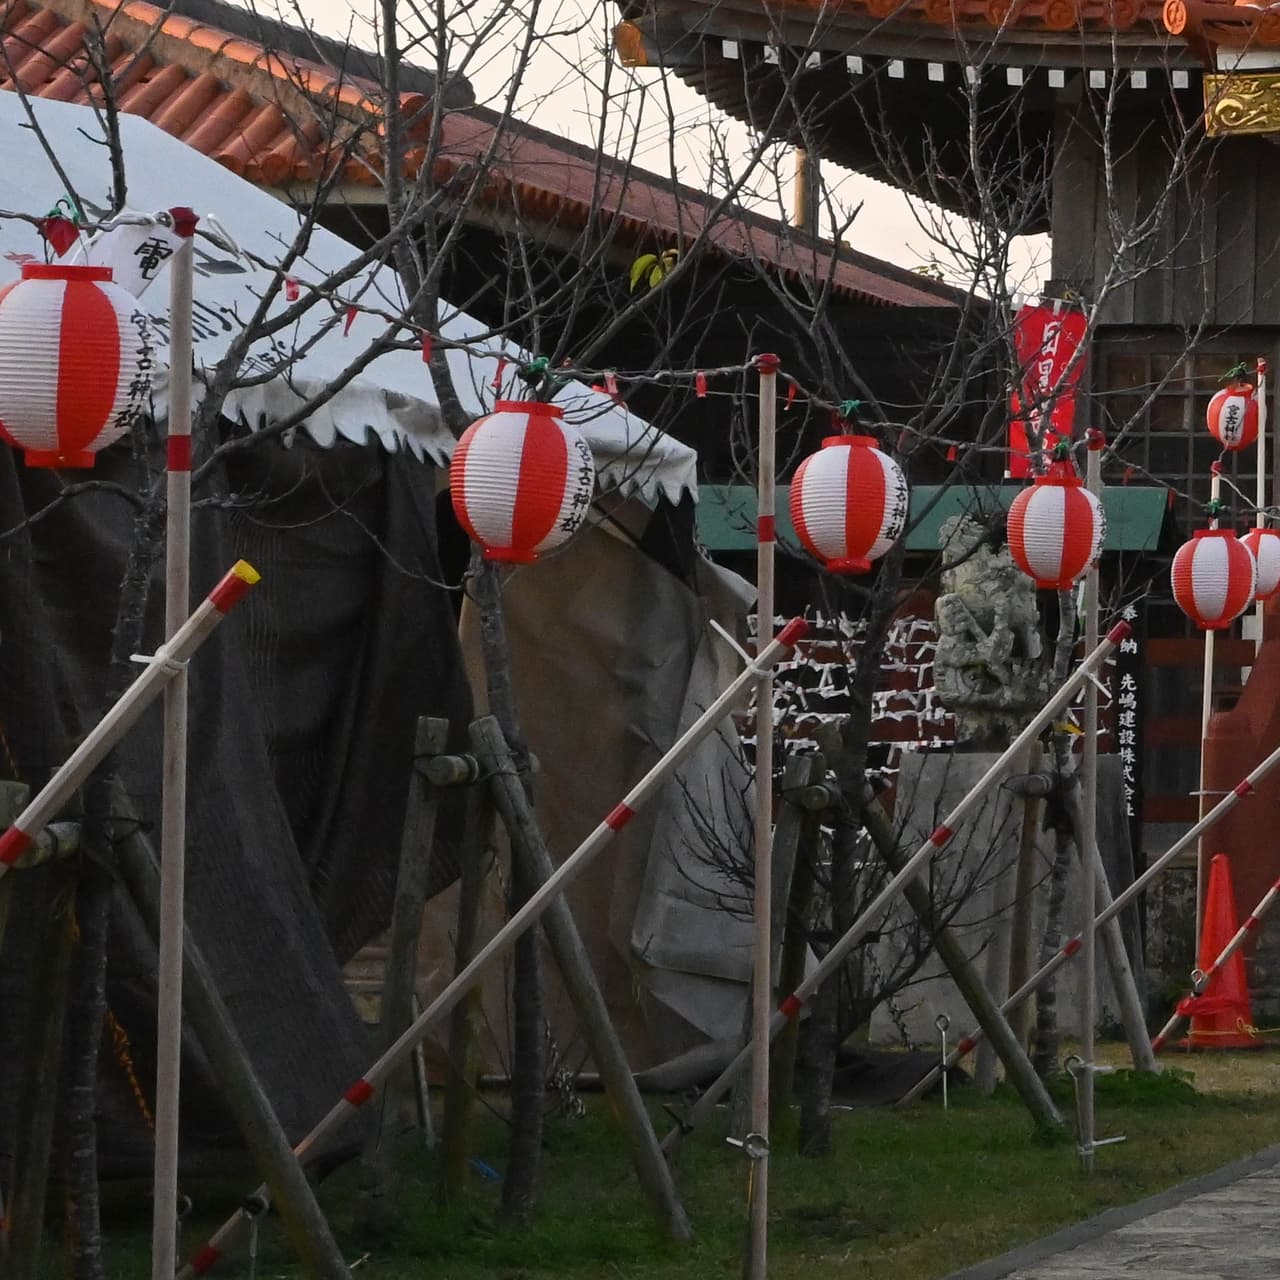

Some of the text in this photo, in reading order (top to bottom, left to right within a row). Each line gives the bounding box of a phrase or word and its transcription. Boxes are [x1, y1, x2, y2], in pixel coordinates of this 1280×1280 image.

[115, 308, 152, 429] 宮古神社
[560, 437, 593, 533] 宮古神社
[1119, 604, 1139, 655] 奉納
